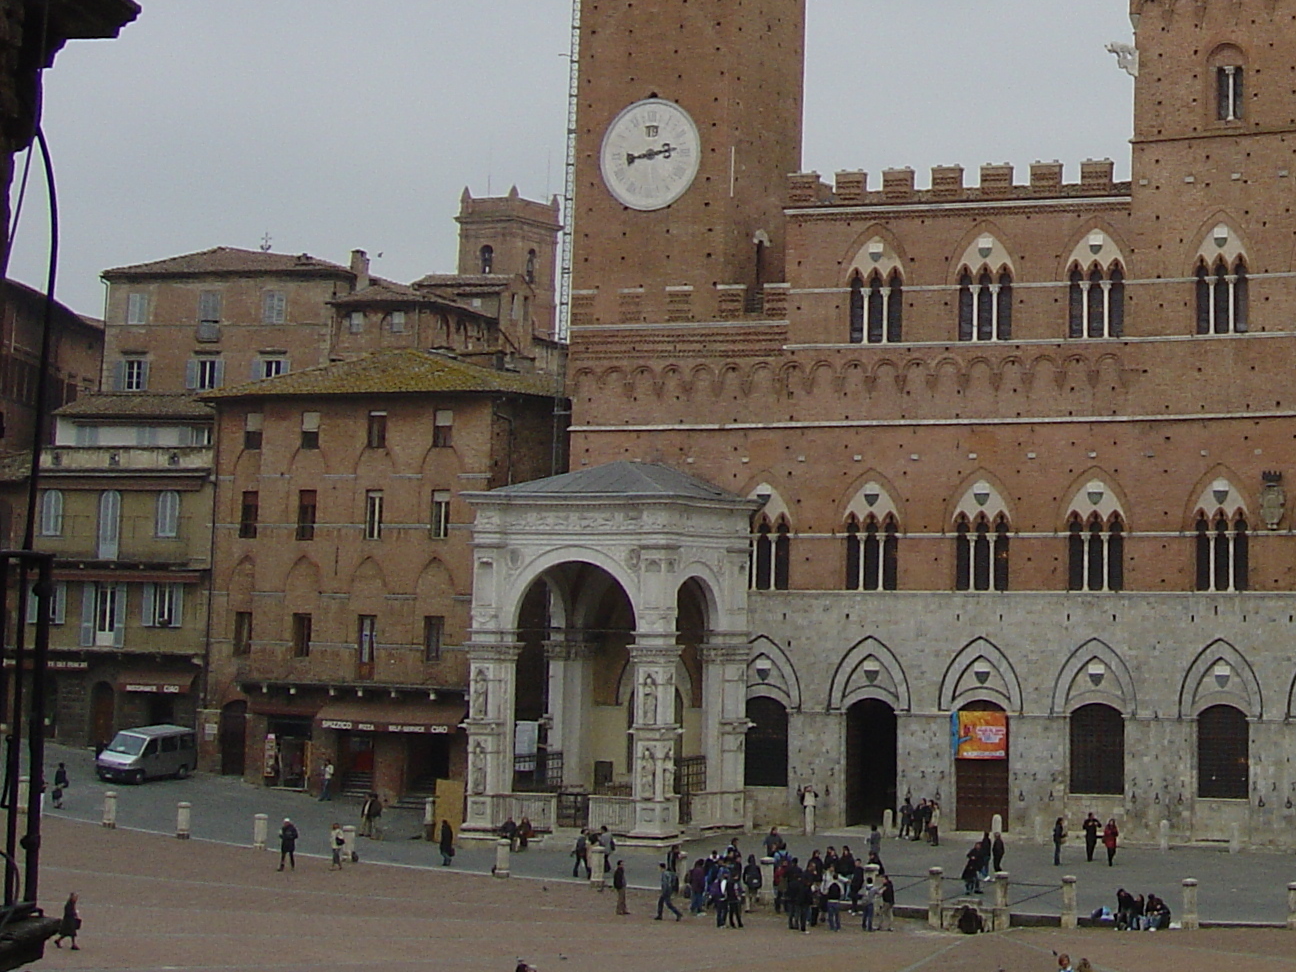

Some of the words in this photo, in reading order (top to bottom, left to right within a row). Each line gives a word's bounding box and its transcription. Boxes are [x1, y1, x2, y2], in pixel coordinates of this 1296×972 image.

[163, 685, 179, 693] CIAO
[322, 720, 352, 729] SPIZZICO
[431, 725, 448, 733] CIAO
